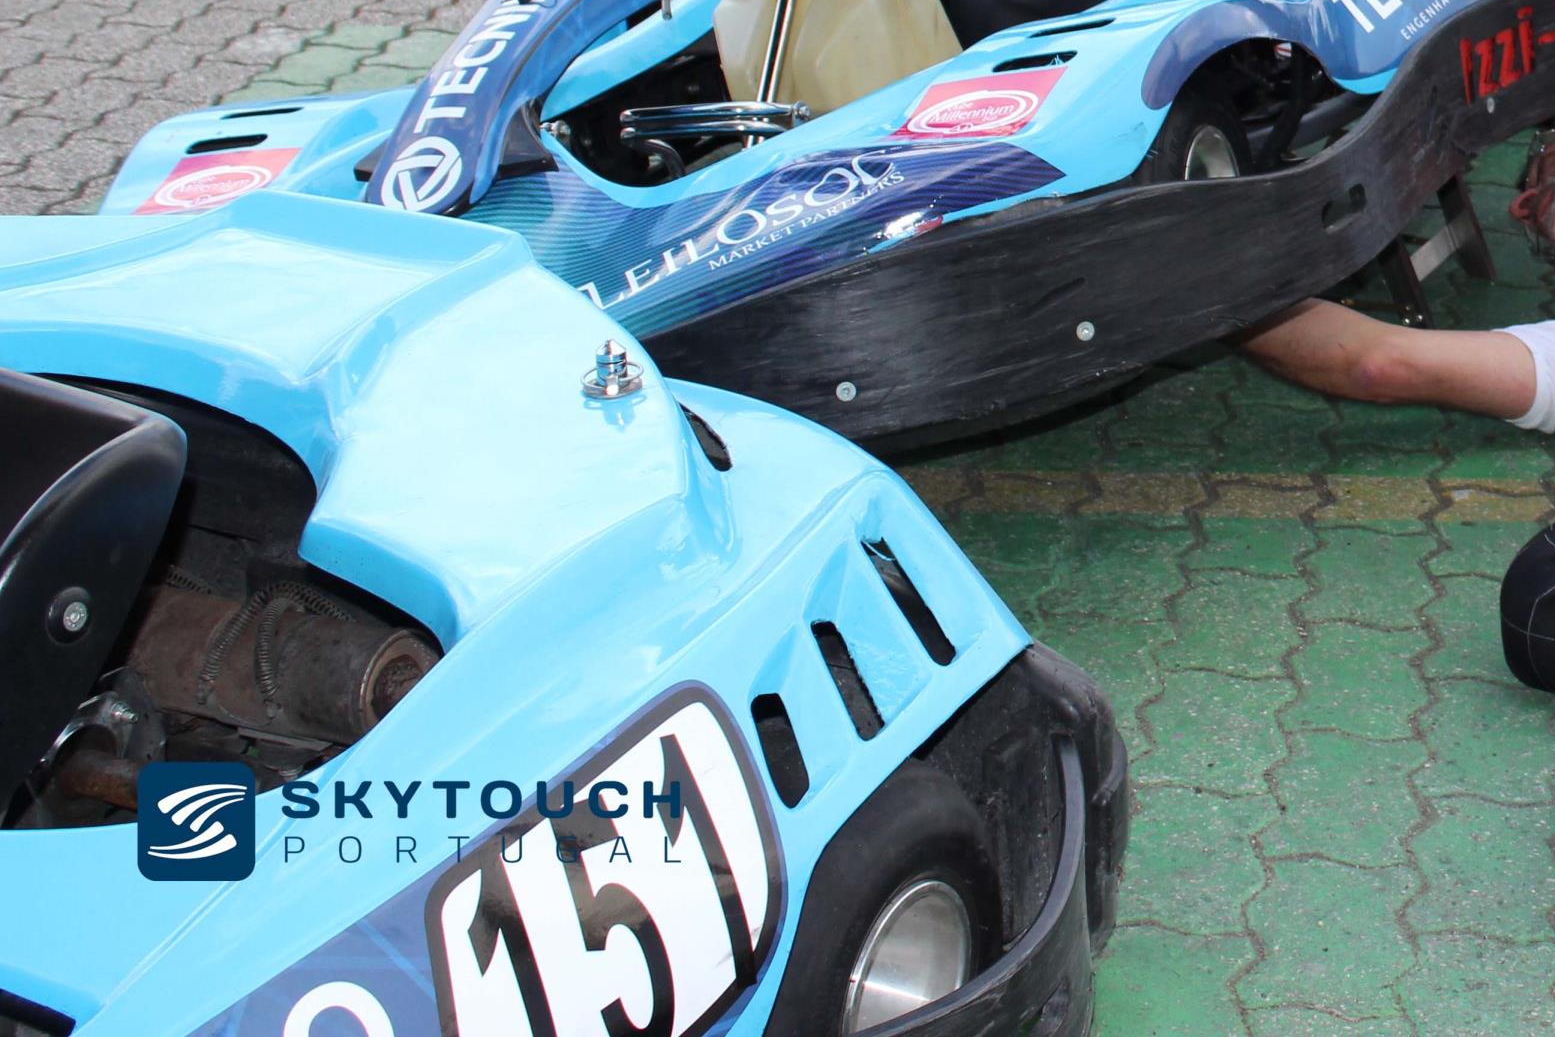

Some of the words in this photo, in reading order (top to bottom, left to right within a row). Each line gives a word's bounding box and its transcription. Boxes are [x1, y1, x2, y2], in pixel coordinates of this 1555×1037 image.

[930, 104, 1015, 124] Millennium
[578, 148, 896, 311] LEILOSOC
[708, 224, 797, 271] MARKET
[800, 170, 906, 227] PARTNERS
[468, 734, 758, 1037] 151
